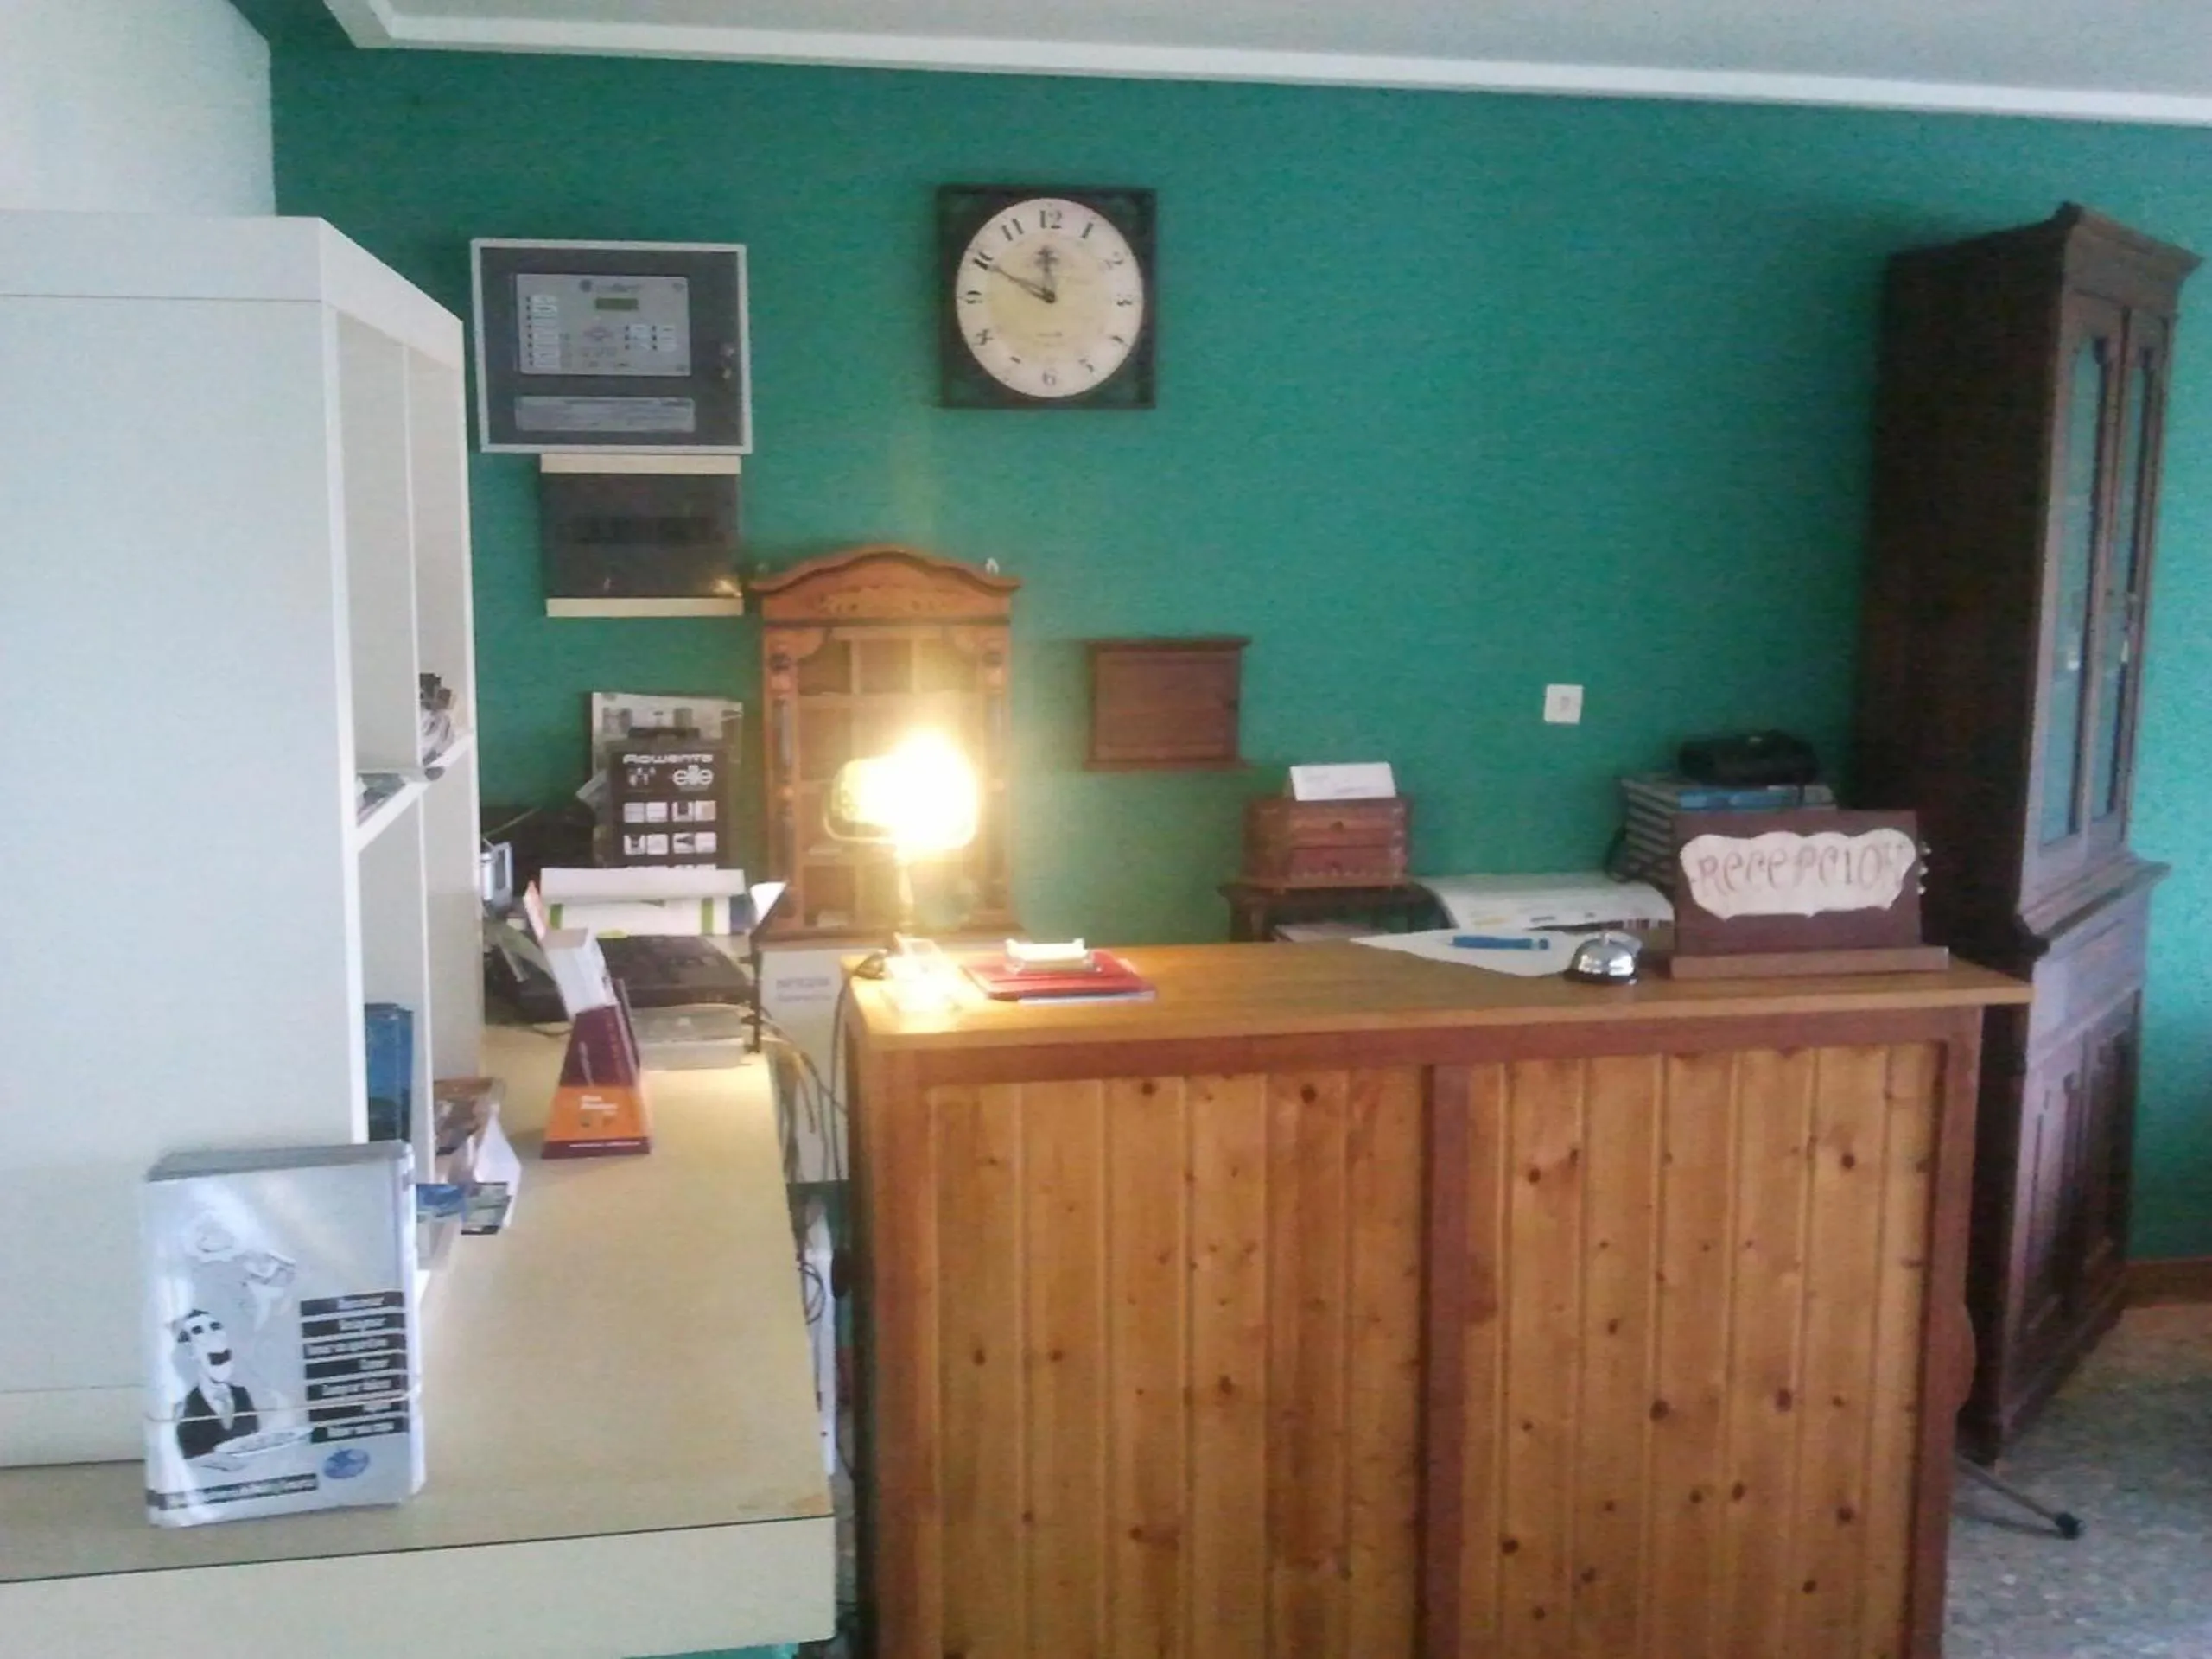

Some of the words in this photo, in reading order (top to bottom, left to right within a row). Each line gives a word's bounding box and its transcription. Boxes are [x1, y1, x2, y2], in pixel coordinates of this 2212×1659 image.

[1039, 209, 1063, 229] 12
[1001, 218, 1024, 241] 11
[1081, 221, 1094, 239] 1
